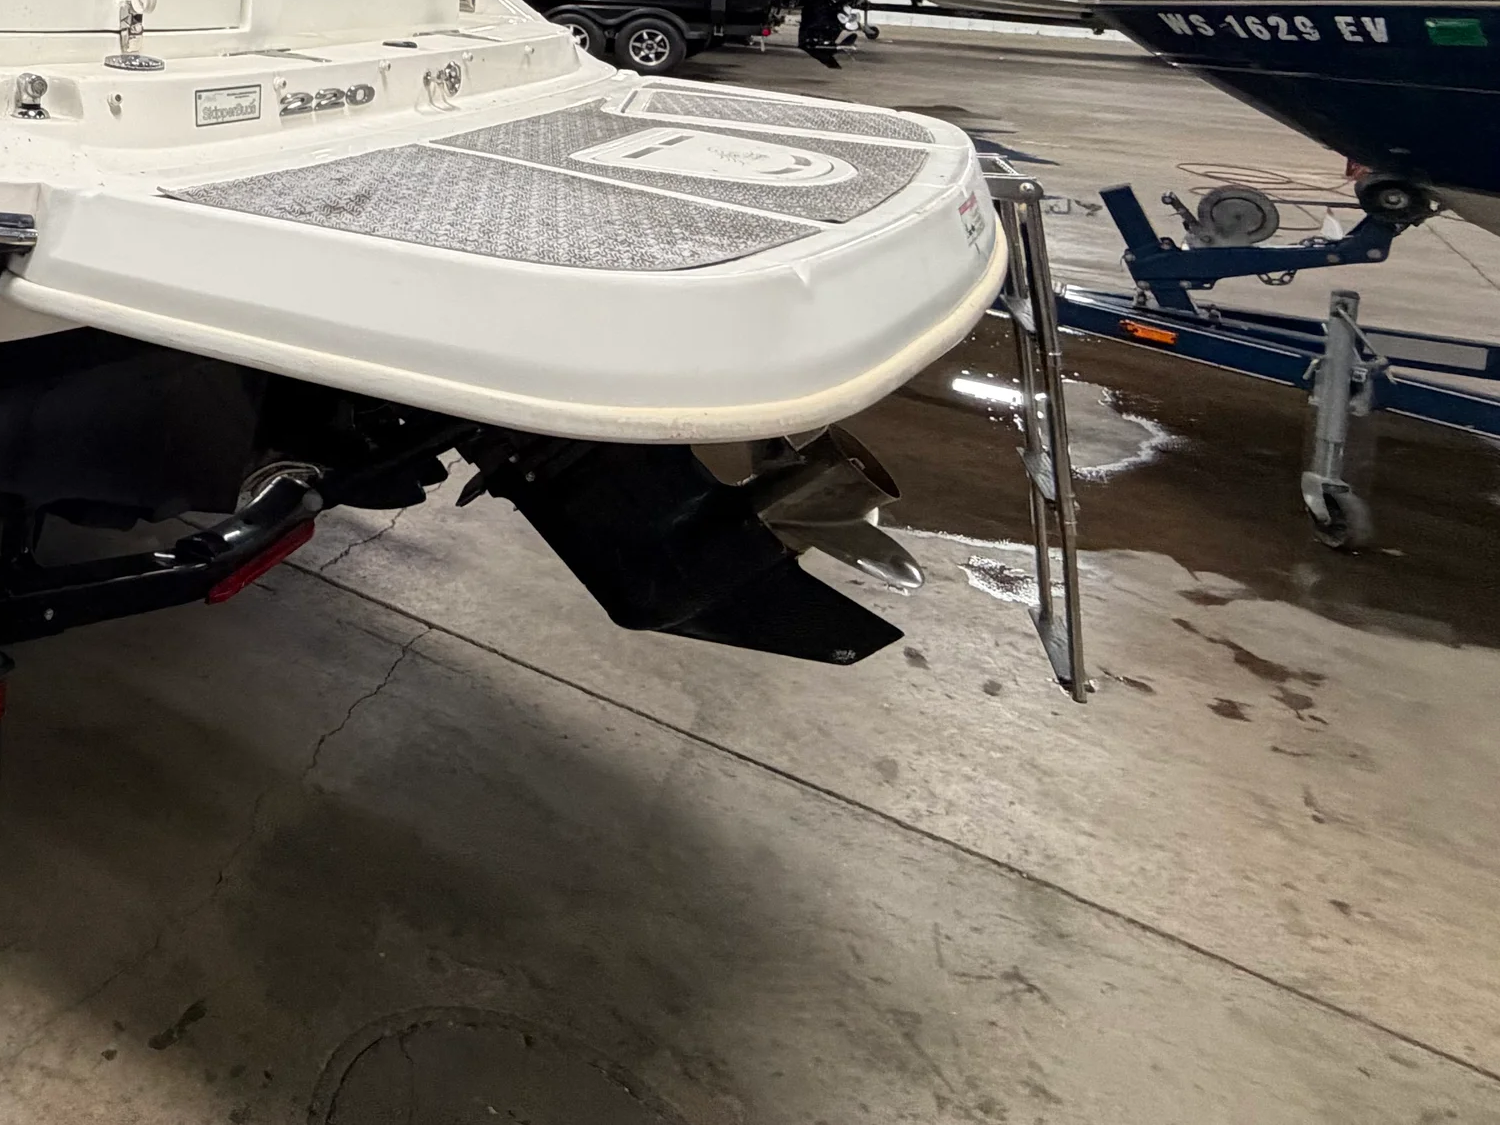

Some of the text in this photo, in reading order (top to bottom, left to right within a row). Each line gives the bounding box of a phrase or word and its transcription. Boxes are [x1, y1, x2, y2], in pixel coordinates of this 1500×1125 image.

[1157, 12, 1216, 37] WS
[1334, 15, 1390, 44] EV
[279, 83, 375, 117] 220
